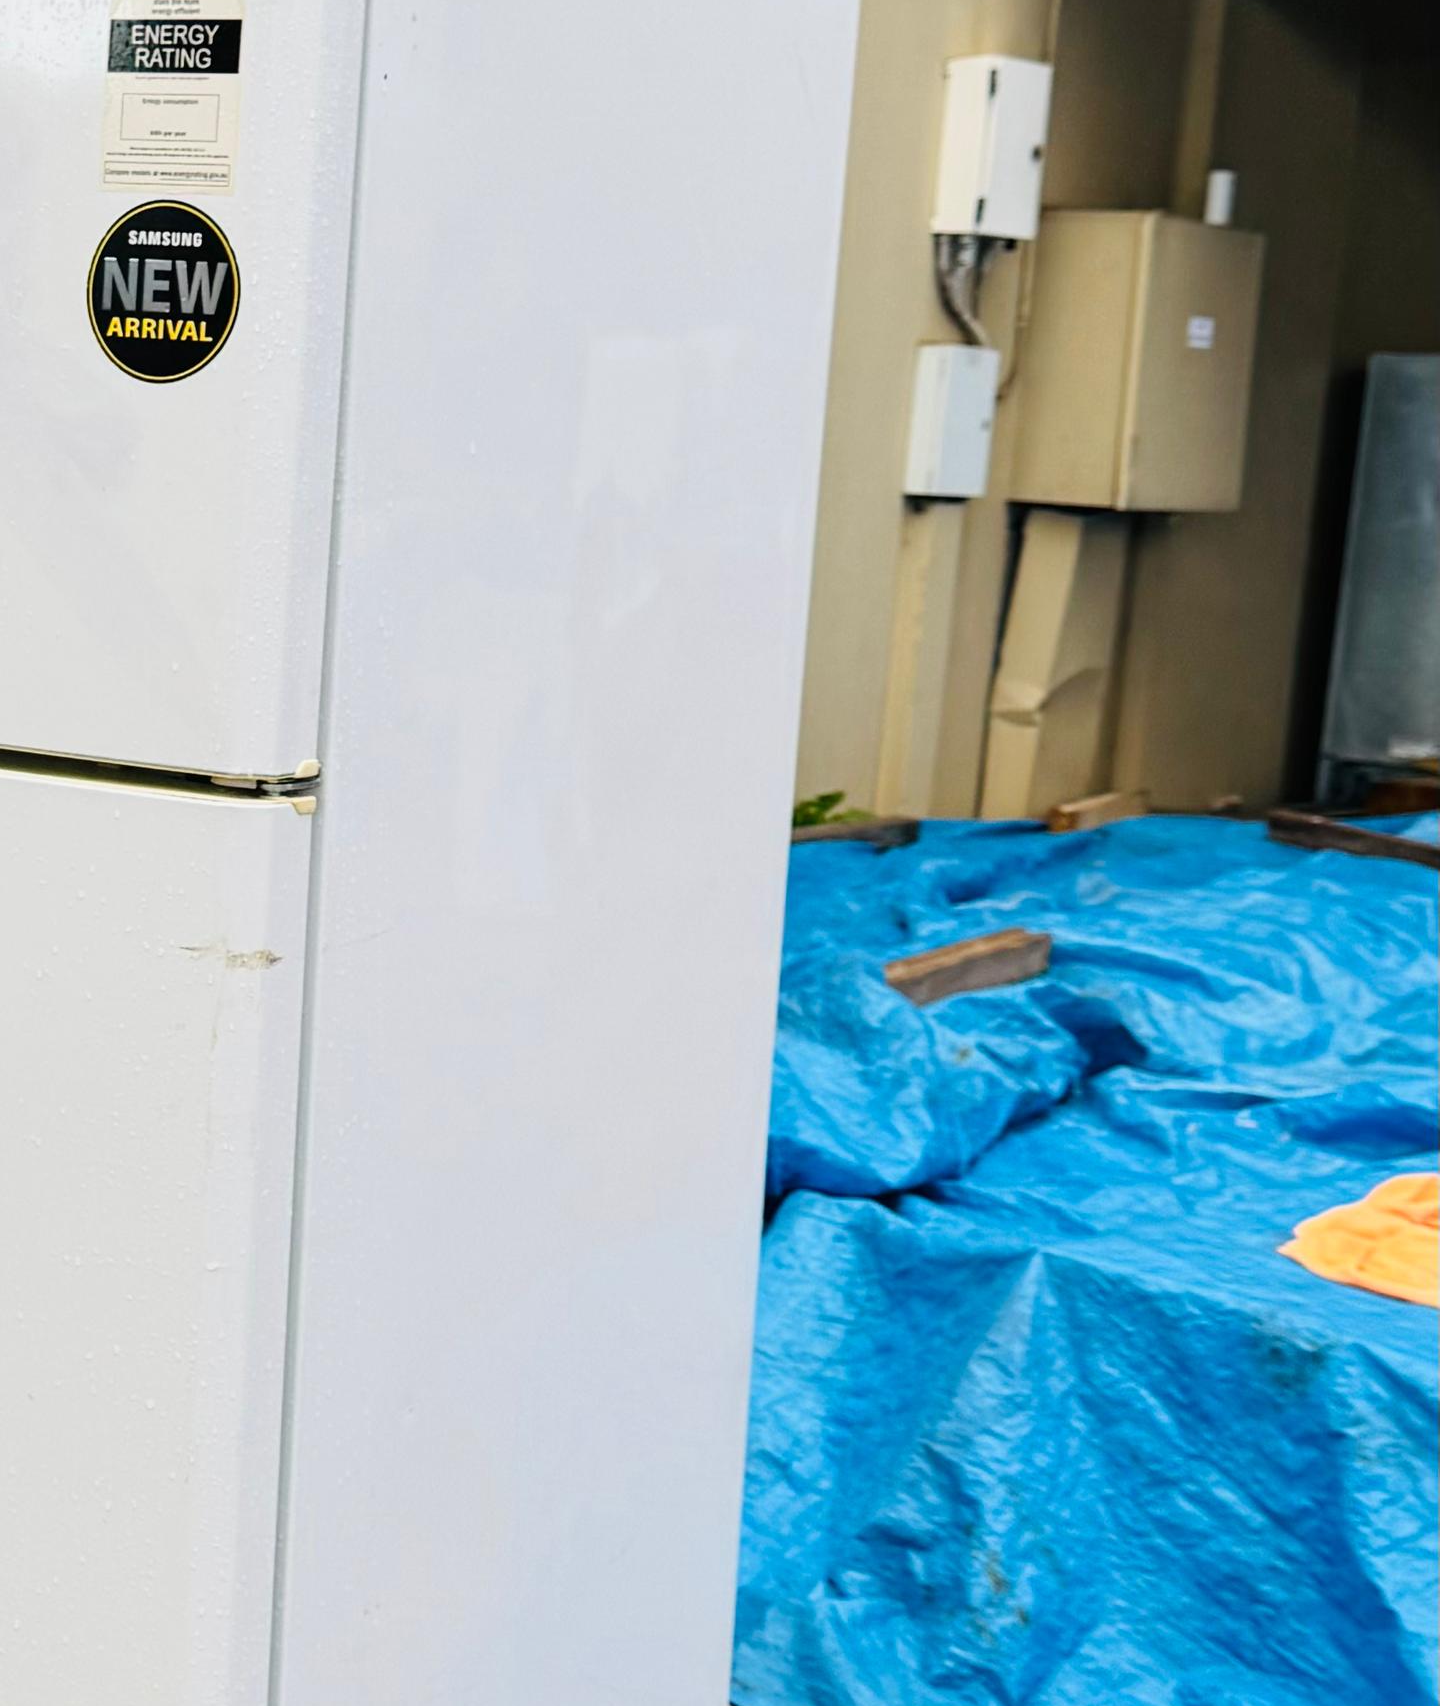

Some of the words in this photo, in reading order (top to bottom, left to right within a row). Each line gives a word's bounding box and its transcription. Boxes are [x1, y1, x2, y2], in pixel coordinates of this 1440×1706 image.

[131, 23, 220, 46] ENERGY
[134, 47, 212, 70] RATING
[127, 229, 204, 248] SAMSUNG
[101, 256, 229, 316] NEW
[106, 316, 214, 343] ARRIVAL
